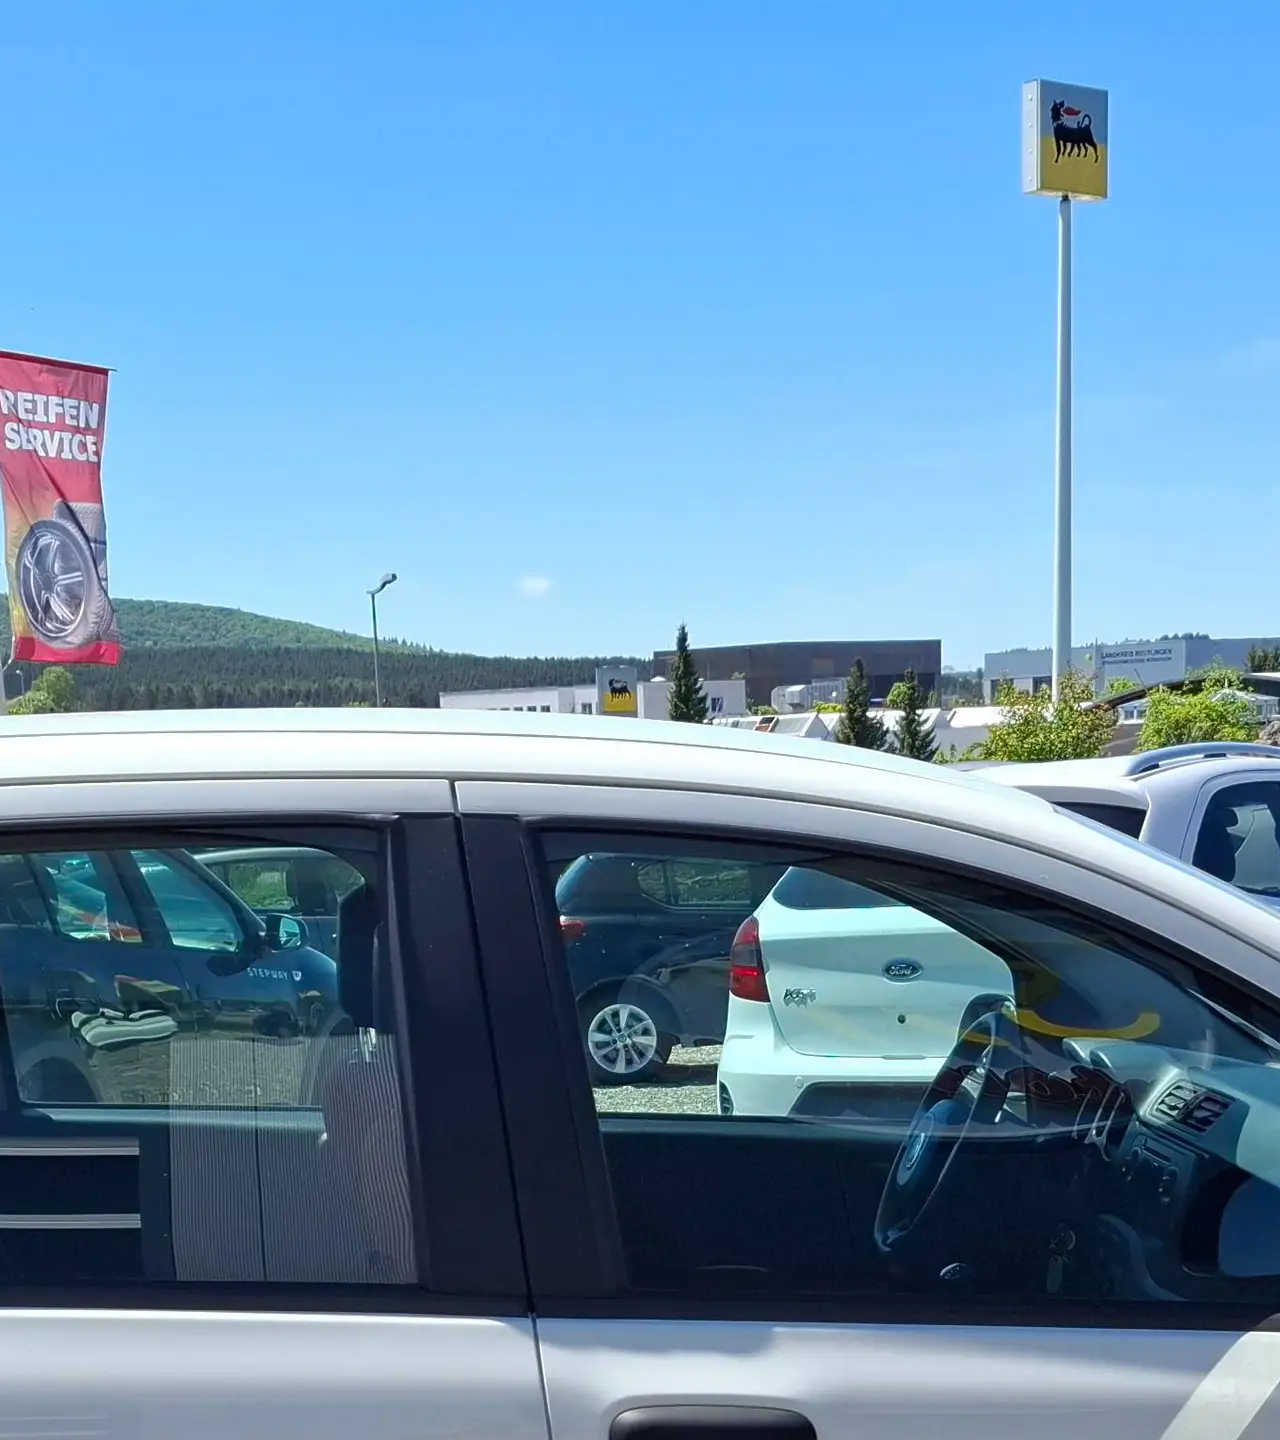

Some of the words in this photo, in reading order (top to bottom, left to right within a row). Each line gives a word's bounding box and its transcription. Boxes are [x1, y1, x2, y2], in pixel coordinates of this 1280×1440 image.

[4, 422, 99, 463] SERVICE
[246, 966, 288, 980] STEPWAY
[889, 963, 913, 975] Ford
